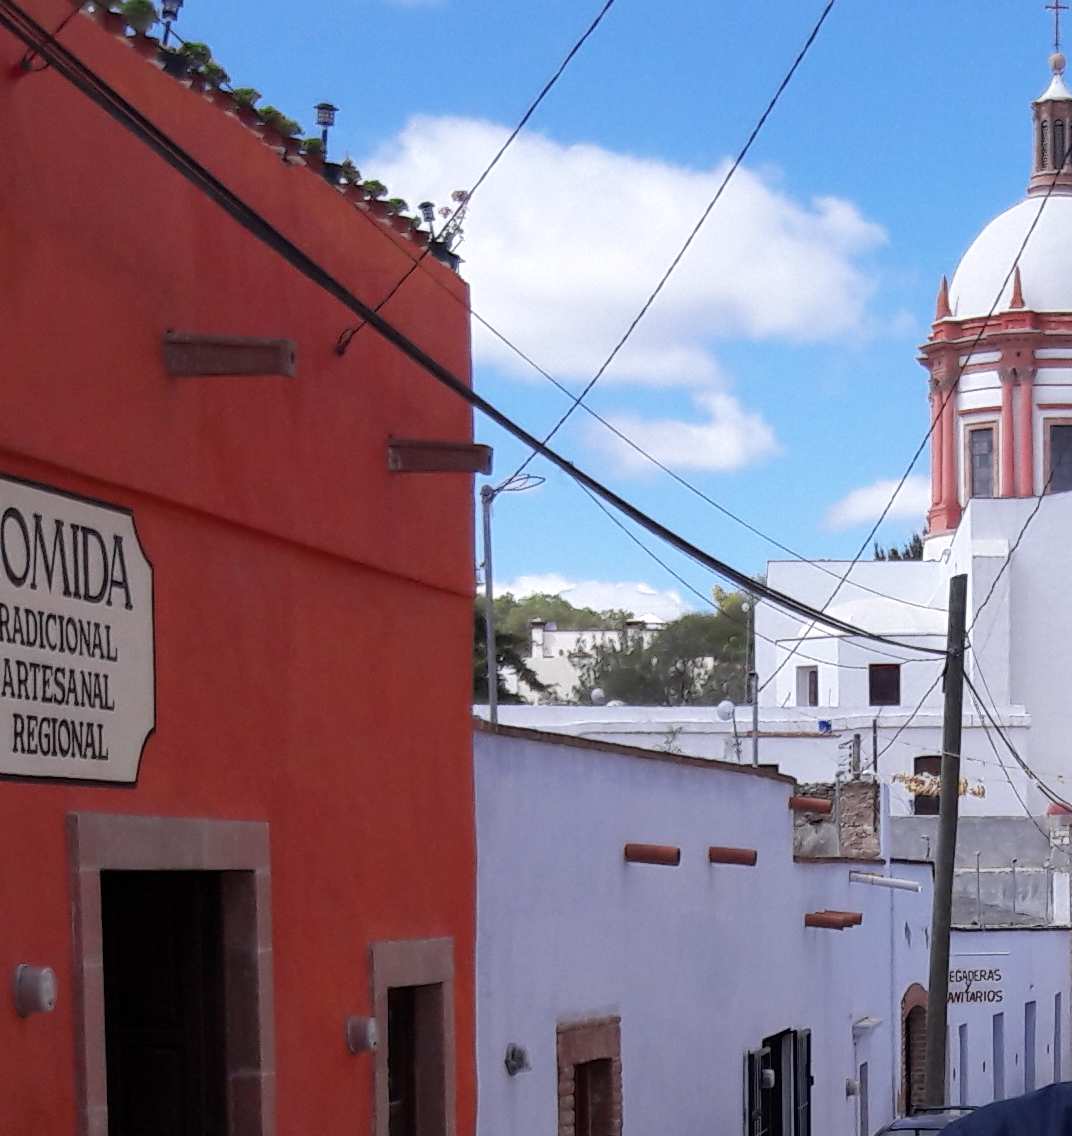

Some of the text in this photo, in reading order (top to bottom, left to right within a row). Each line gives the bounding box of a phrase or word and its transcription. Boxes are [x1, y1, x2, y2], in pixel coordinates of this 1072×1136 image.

[0, 507, 133, 611] OMIDA
[0, 602, 118, 663] RADICIONAL
[1, 658, 115, 712] ARTESANAL
[13, 713, 109, 762] REGIONAL
[947, 990, 1004, 1004] ANITARIOS
[949, 969, 1002, 983] EGADERAS
